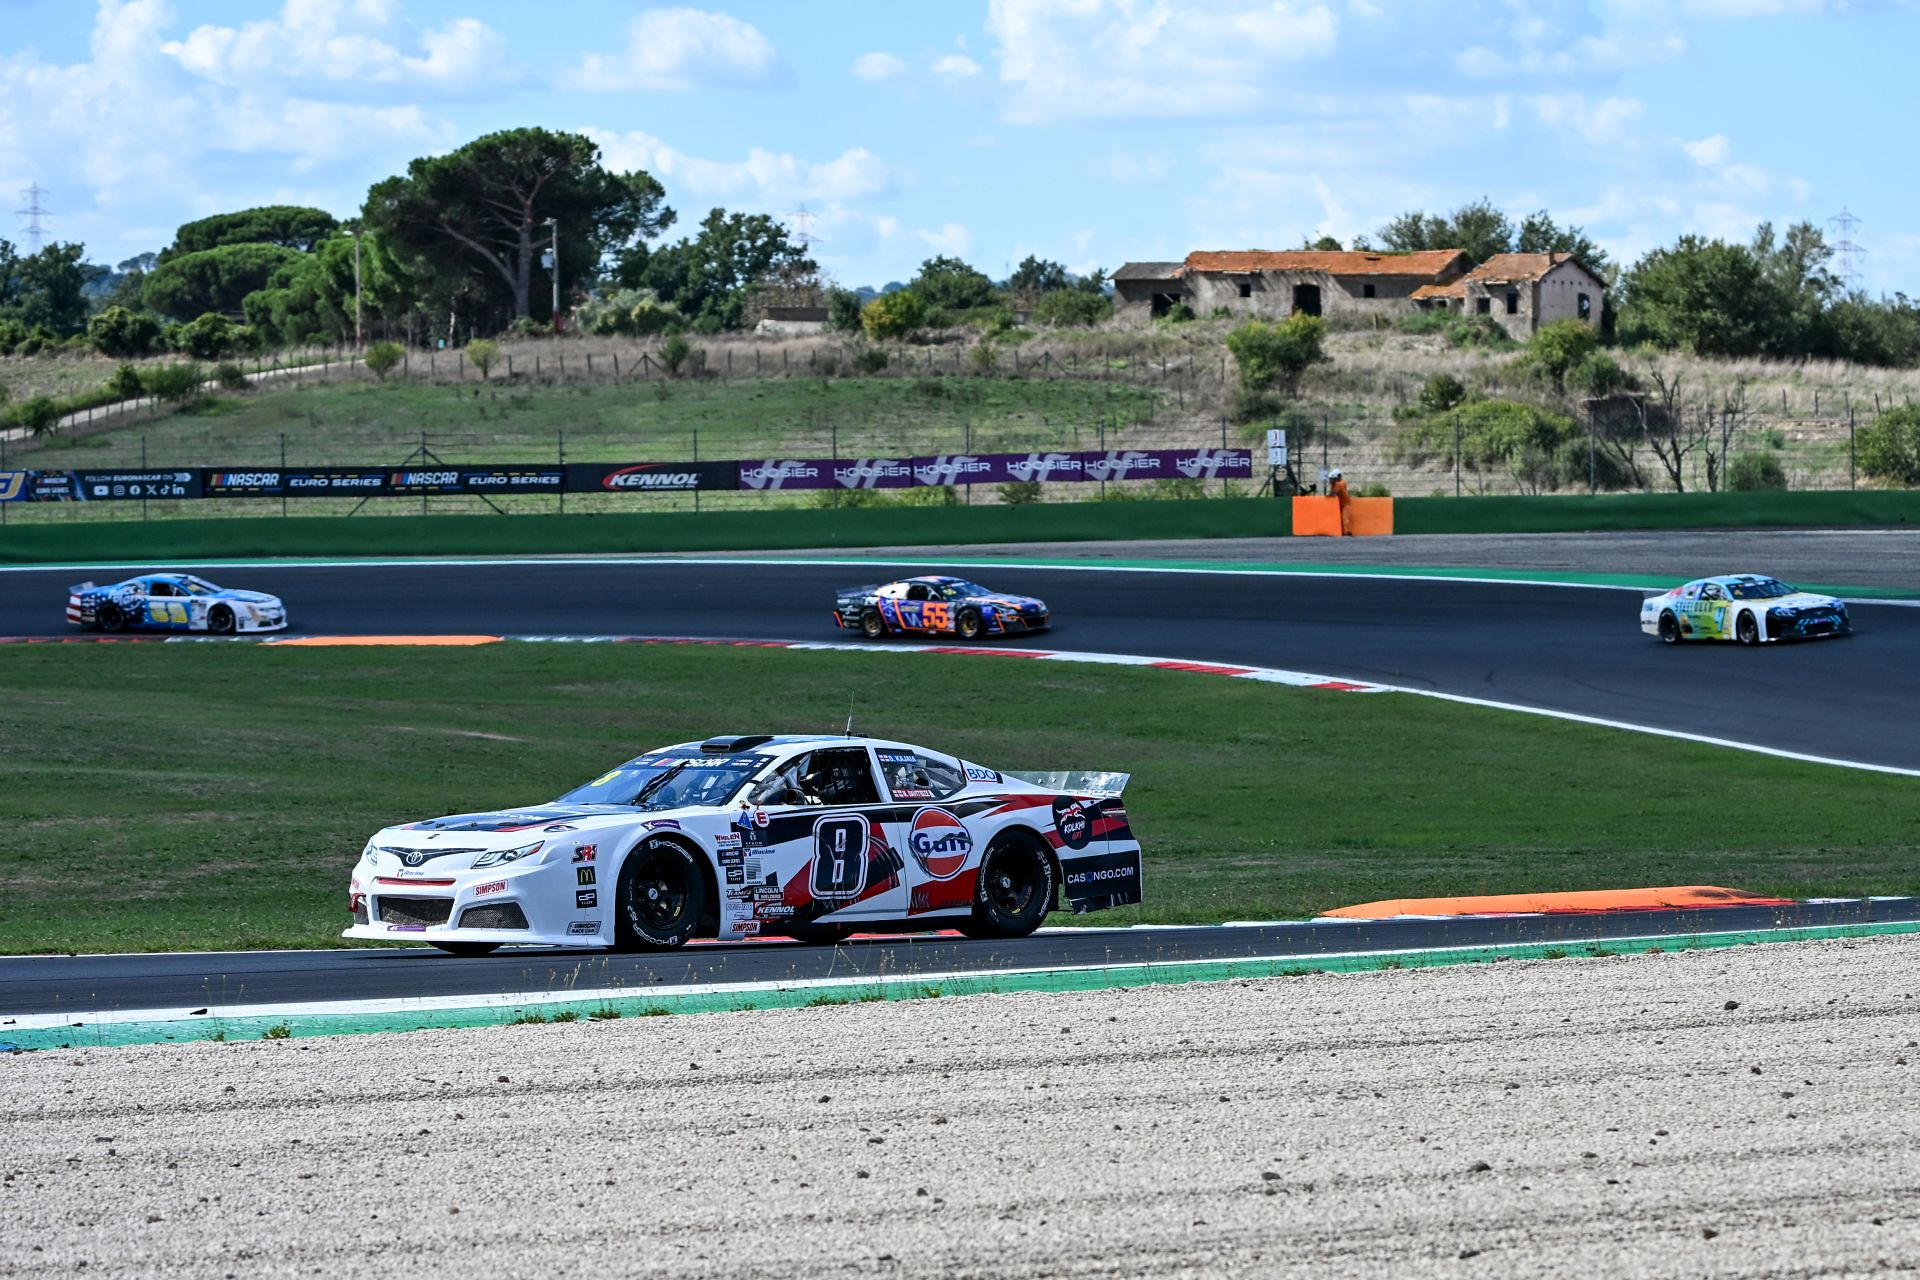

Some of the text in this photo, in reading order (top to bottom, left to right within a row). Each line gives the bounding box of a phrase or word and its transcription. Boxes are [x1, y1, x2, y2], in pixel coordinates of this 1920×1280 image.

[913, 462, 991, 475] HOOSIER
[1006, 460, 1082, 472] HOOSIER
[1083, 458, 1161, 471] HOOSIER
[1176, 457, 1251, 468] HOOSIER
[407, 471, 458, 485] NASCAR
[740, 467, 819, 479] HOOSIER
[834, 466, 911, 478] HOOSIER
[85, 475, 112, 483] FOLLOW
[113, 474, 162, 483] EURONASCAR
[227, 473, 280, 487] NASCAR
[289, 478, 382, 487] EURO SERIES
[468, 476, 560, 485] EURO SERIES
[609, 473, 699, 486] KENNOL
[922, 601, 949, 629] 55
[967, 768, 996, 780] BDO
[757, 812, 767, 825] E
[715, 833, 741, 841] WHELEN
[913, 832, 967, 854] Gulf
[657, 841, 694, 863] HOOSIER
[809, 813, 870, 900] 8
[474, 881, 507, 896] SIMPSON
[755, 887, 779, 895] LINCOLN
[757, 906, 795, 914] KENNOL
[732, 922, 758, 932] SIMPSON
